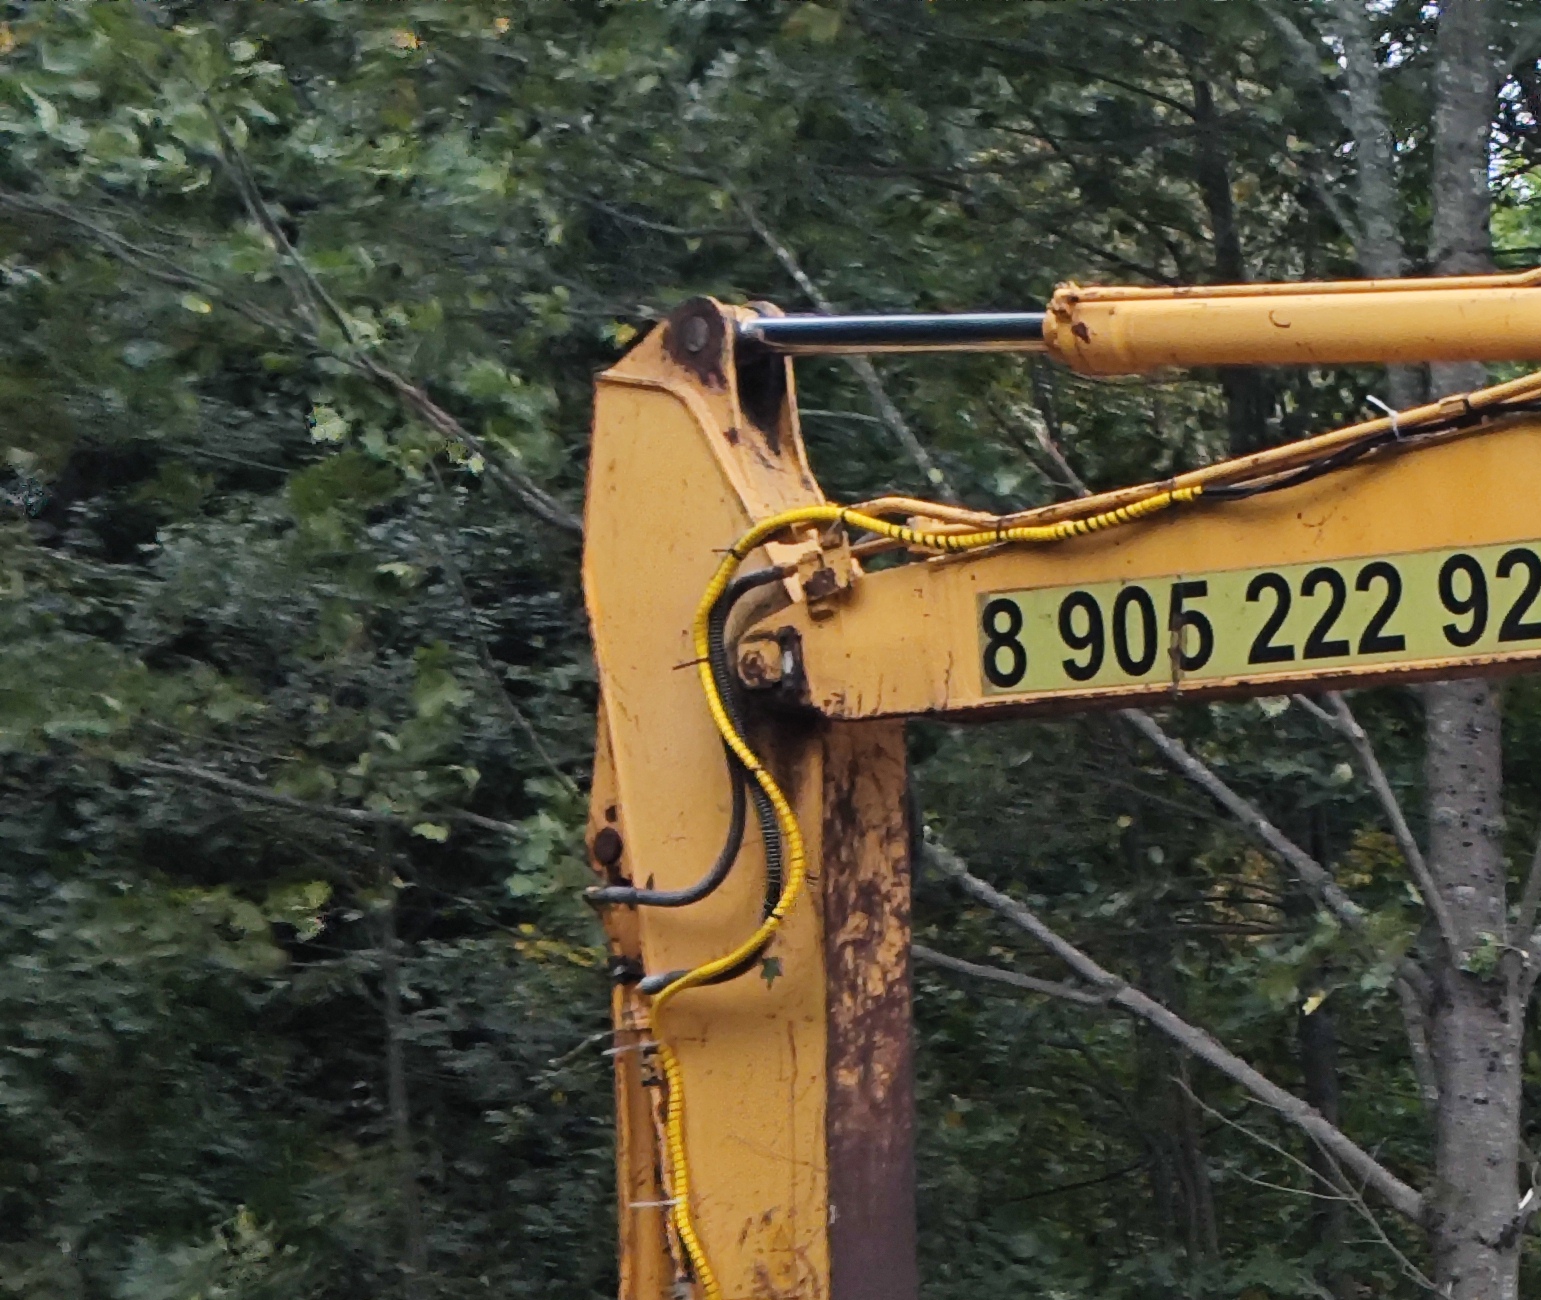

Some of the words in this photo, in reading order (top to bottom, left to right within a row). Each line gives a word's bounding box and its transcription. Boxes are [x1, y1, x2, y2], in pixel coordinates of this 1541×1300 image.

[981, 599, 1027, 688] 8
[1057, 581, 1214, 682] 905
[1246, 561, 1405, 665] 222
